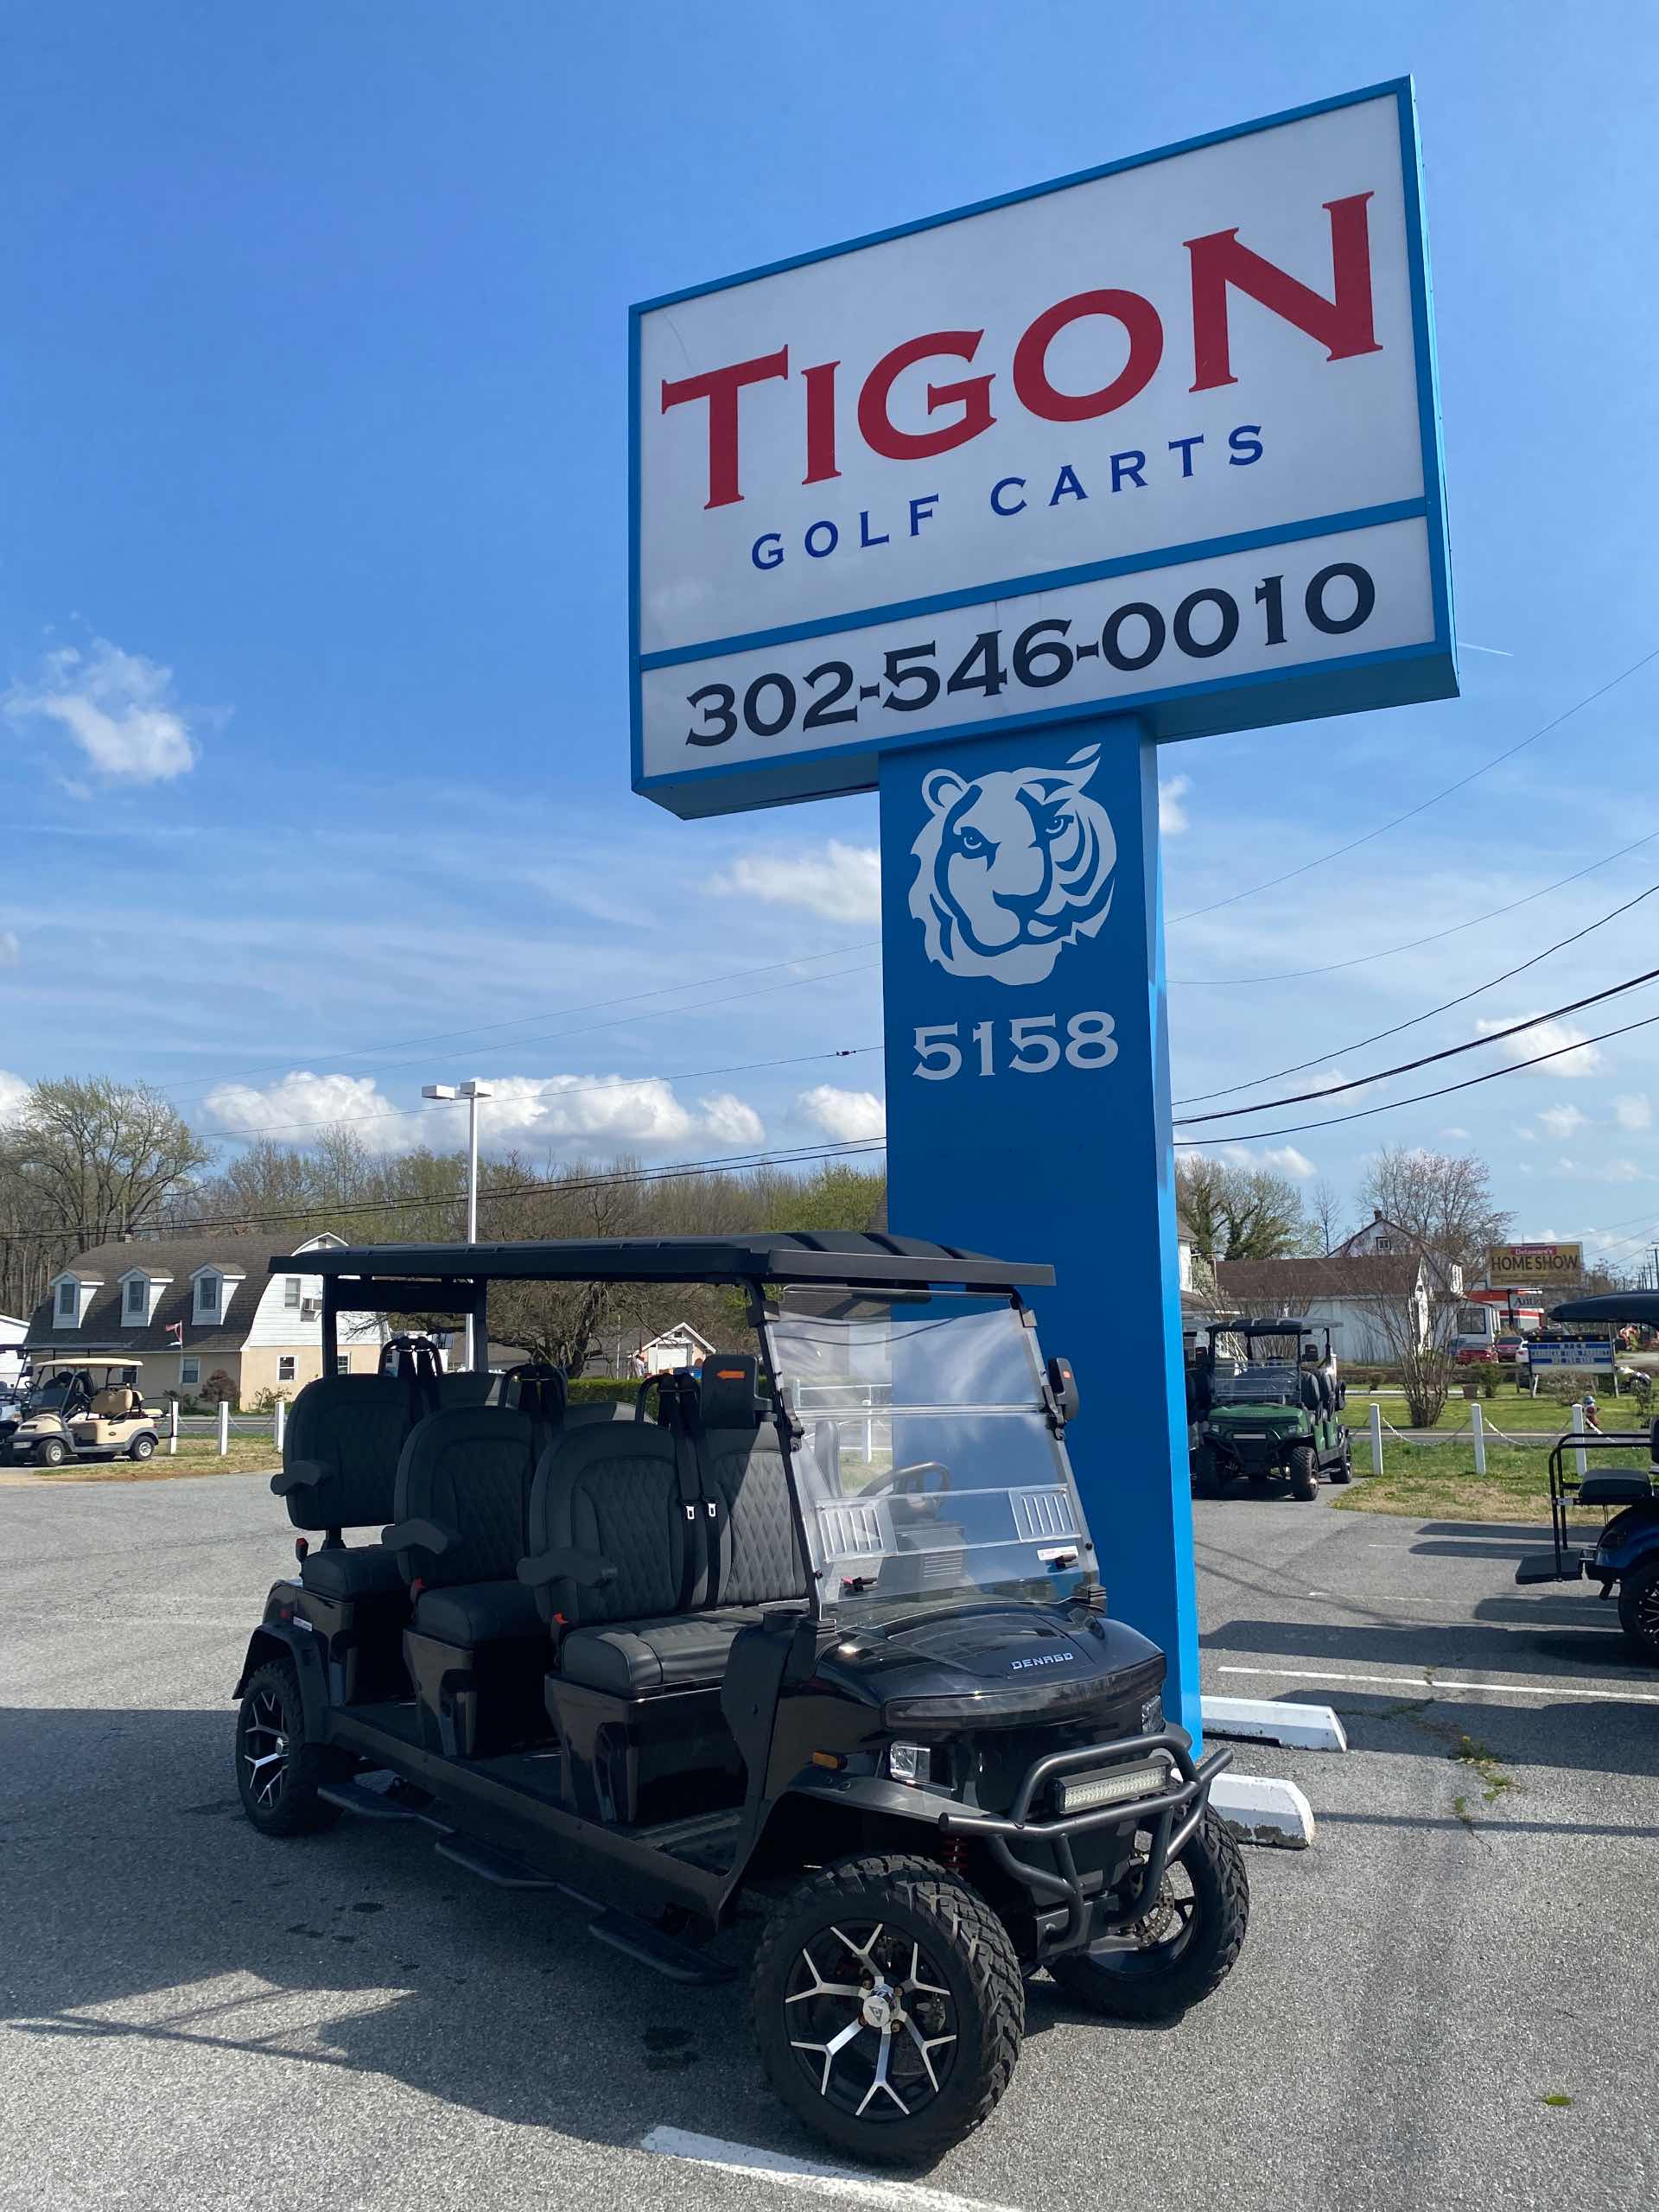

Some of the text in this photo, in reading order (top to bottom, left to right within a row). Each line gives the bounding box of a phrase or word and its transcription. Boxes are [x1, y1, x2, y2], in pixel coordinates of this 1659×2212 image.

[661, 192, 1382, 508] TIGON
[752, 424, 1264, 570] GOLF CARTS
[685, 562, 1376, 747] 302-546-0010
[912, 1010, 1119, 1080] 5158
[1492, 1254, 1579, 1272] HOME SHOW
[1011, 1652, 1074, 1670] DENAGO
